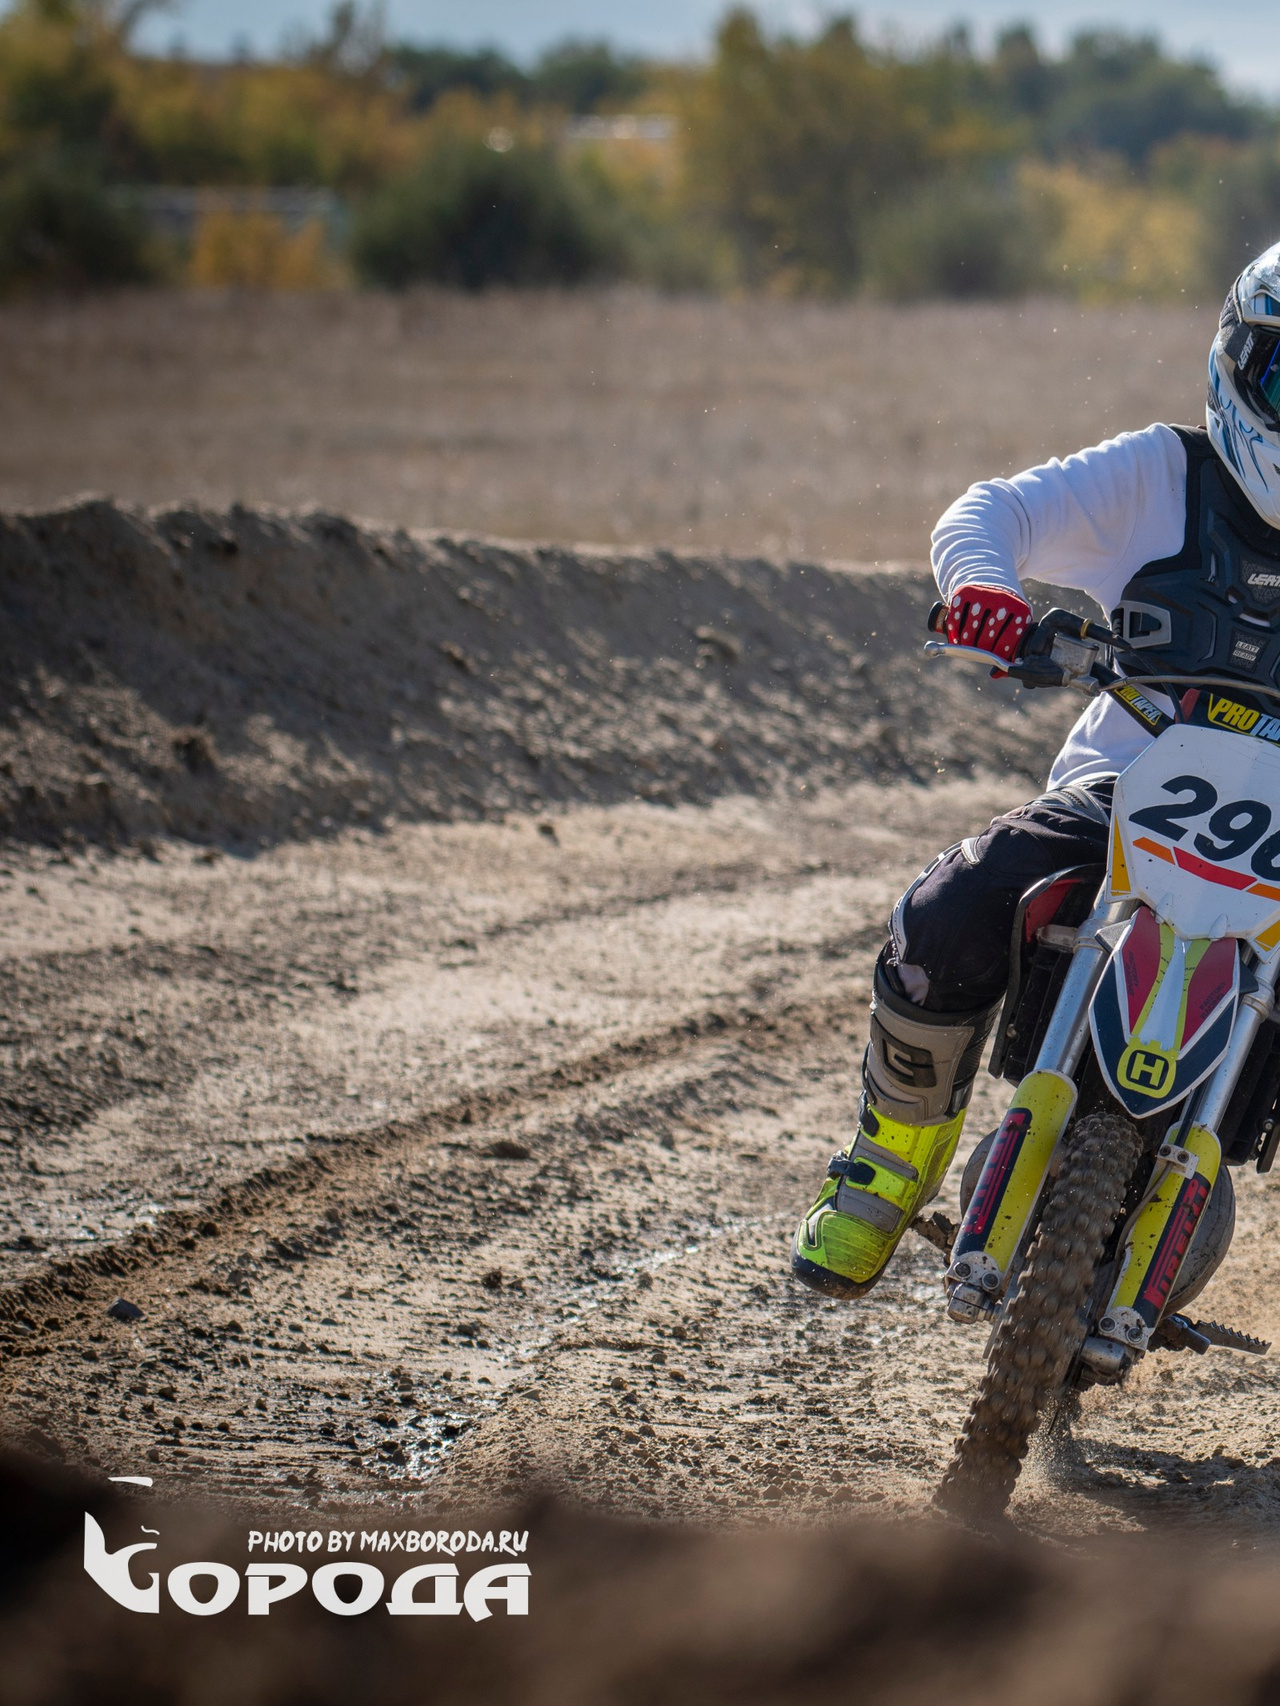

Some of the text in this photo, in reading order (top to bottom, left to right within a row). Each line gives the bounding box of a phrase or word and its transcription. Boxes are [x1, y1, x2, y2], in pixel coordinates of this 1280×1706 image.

[1236, 641, 1259, 653] LEATT
[1233, 650, 1256, 661] READY
[1130, 1052, 1165, 1087] H
